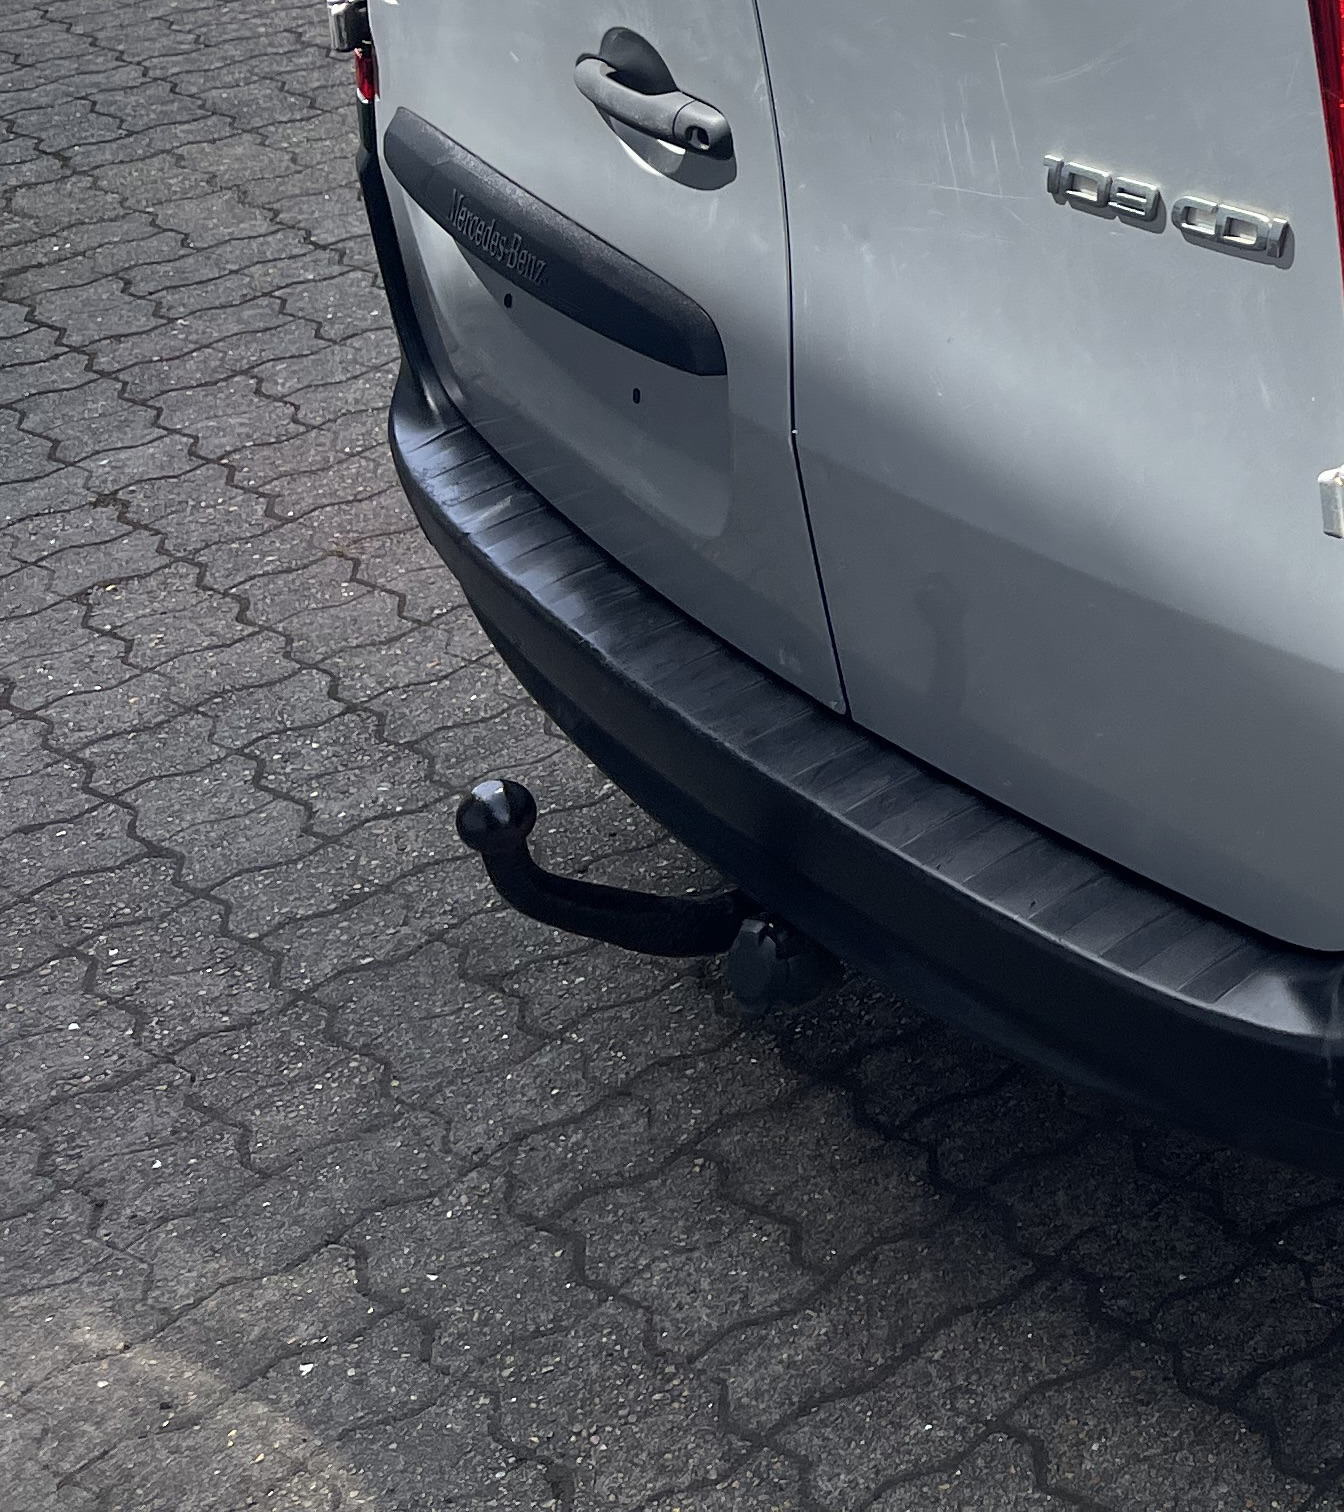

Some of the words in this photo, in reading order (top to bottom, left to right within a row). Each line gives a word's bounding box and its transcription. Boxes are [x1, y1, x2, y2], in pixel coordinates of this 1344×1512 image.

[448, 187, 548, 287] Mercedes-Benz
[1043, 154, 1160, 223] 109
[1170, 194, 1290, 259] CDI
